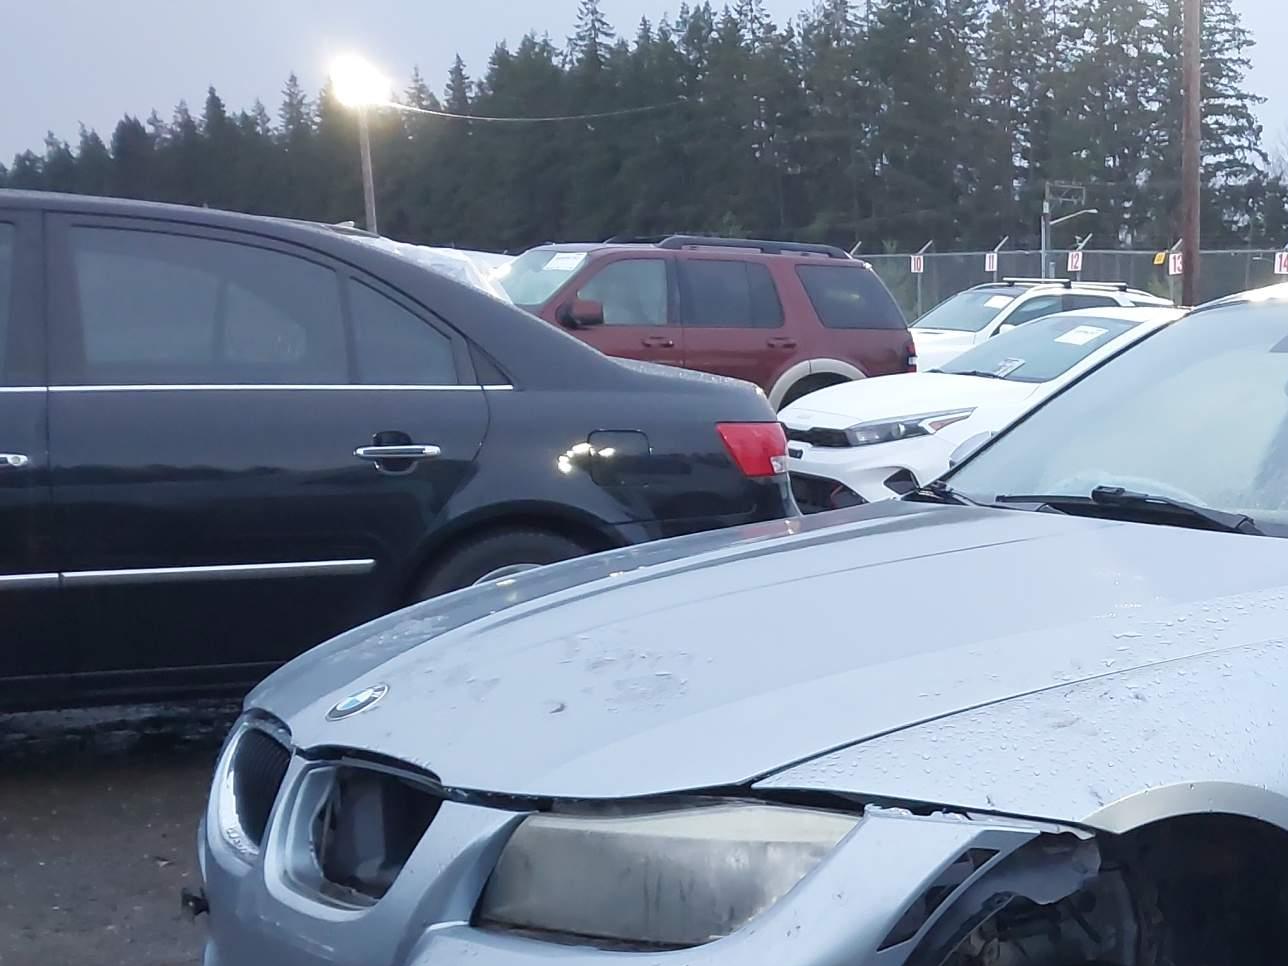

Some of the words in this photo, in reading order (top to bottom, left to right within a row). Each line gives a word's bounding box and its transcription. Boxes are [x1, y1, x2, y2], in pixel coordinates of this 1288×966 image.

[913, 256, 922, 271] 10
[988, 256, 995, 270] 11
[1071, 252, 1080, 269] 12
[1172, 254, 1183, 273] 13
